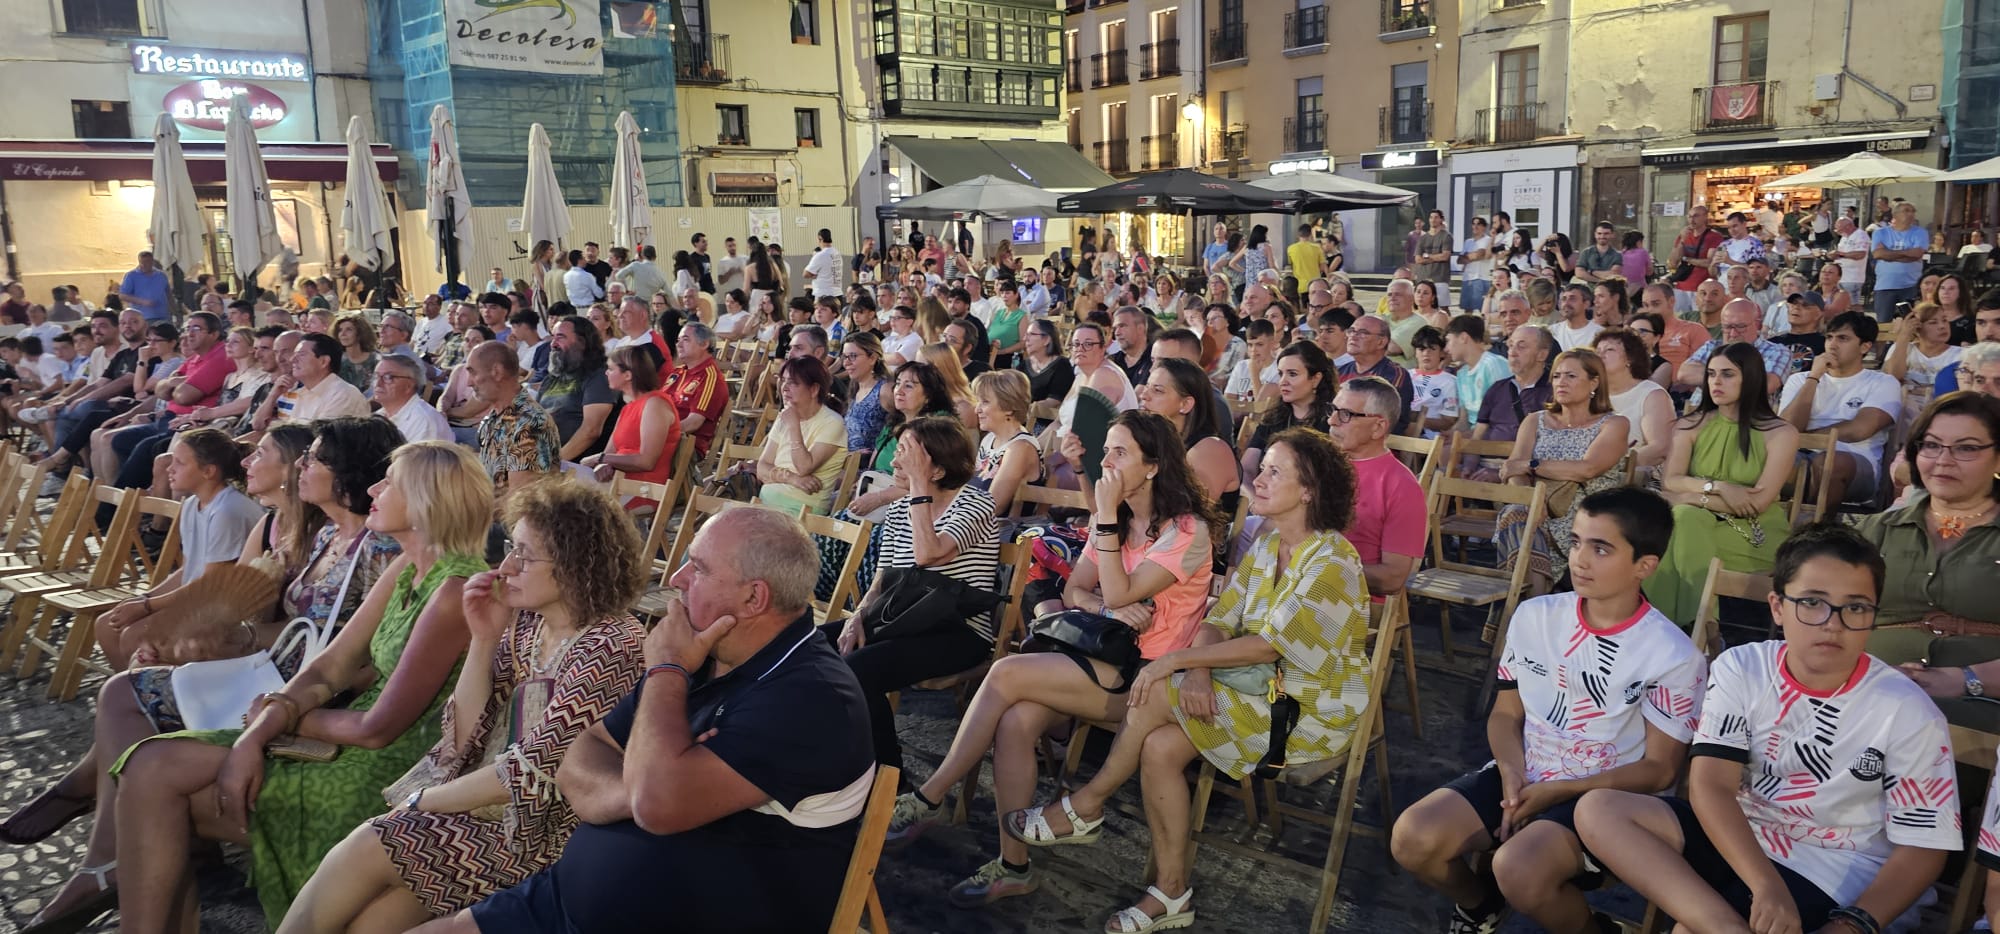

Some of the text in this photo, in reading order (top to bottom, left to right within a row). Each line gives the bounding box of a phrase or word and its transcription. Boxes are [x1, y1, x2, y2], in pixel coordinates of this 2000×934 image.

[456, 19, 597, 51] Decolesa
[135, 45, 305, 78] Restaurante
[196, 100, 285, 125] Capcho
[1654, 154, 1700, 163] TABERNA
[12, 163, 86, 180] El Capricho
